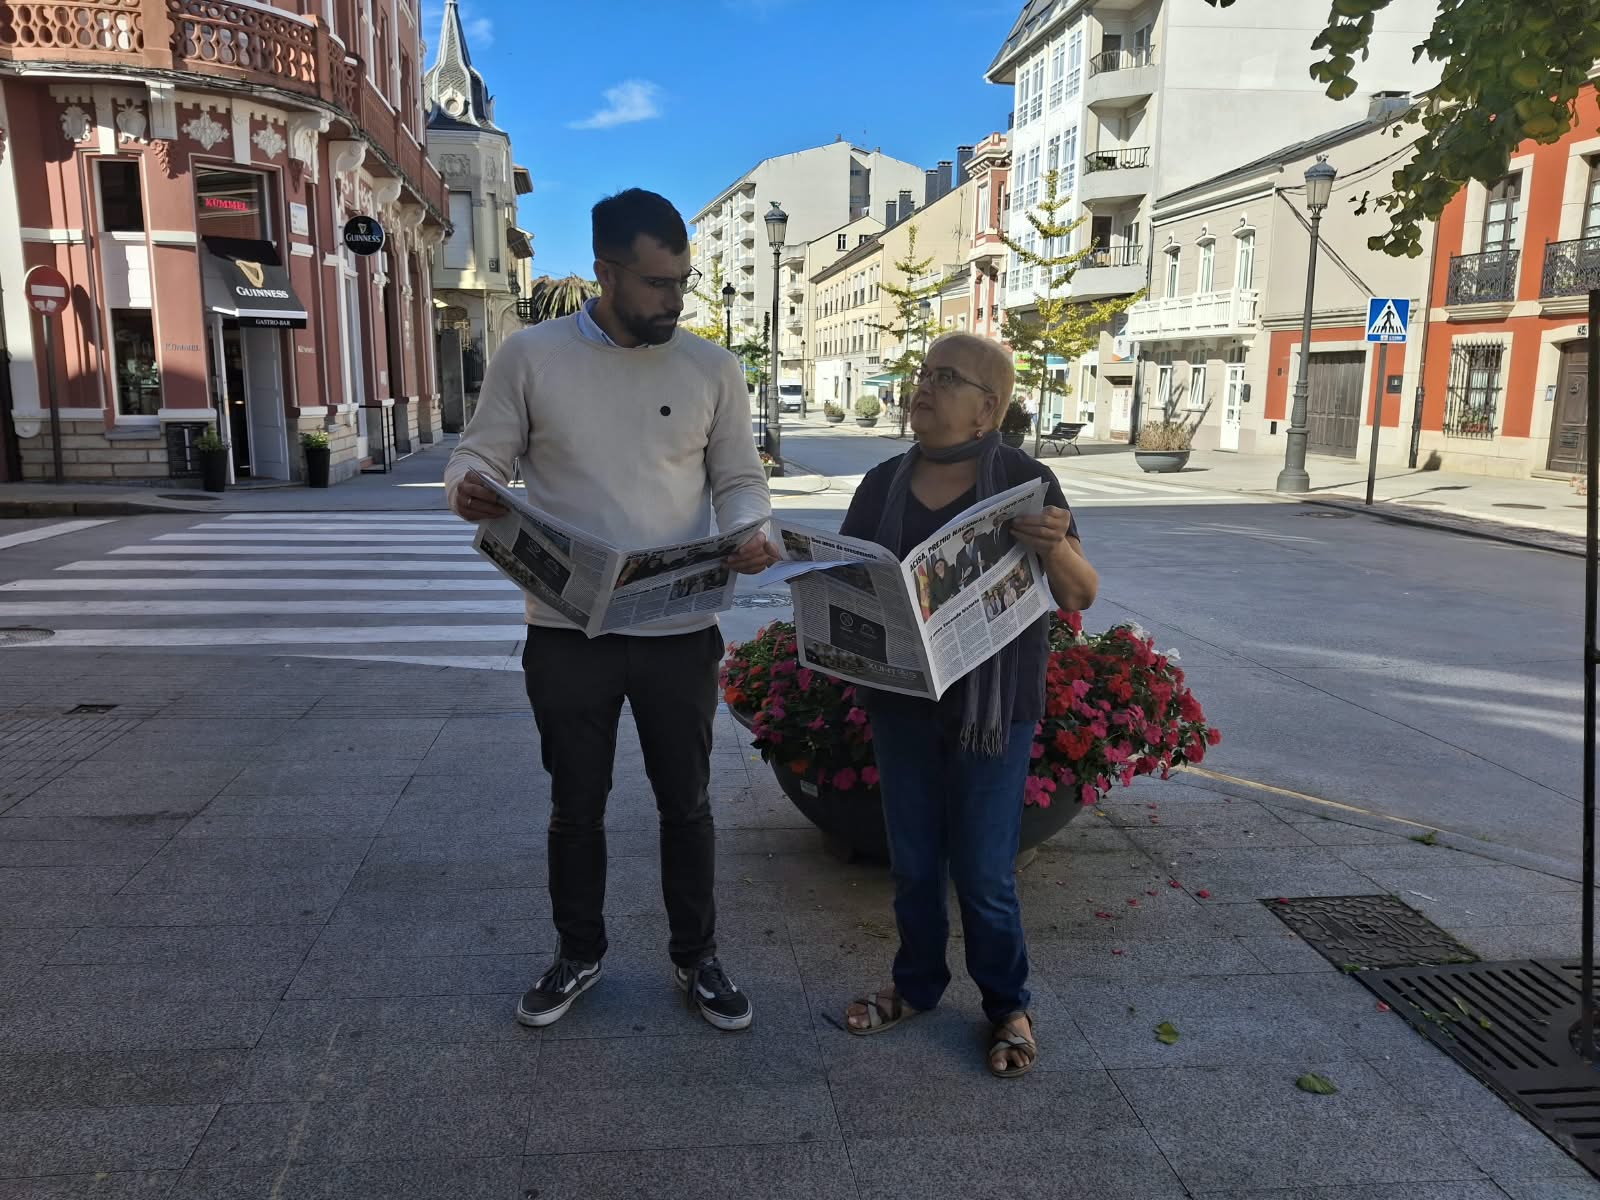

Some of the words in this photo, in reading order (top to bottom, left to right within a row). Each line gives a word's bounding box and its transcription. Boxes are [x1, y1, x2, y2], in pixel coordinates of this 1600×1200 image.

[345, 233, 381, 243] GUINNESS
[236, 286, 289, 299] GUINNESS
[928, 533, 951, 553] PREMIO
